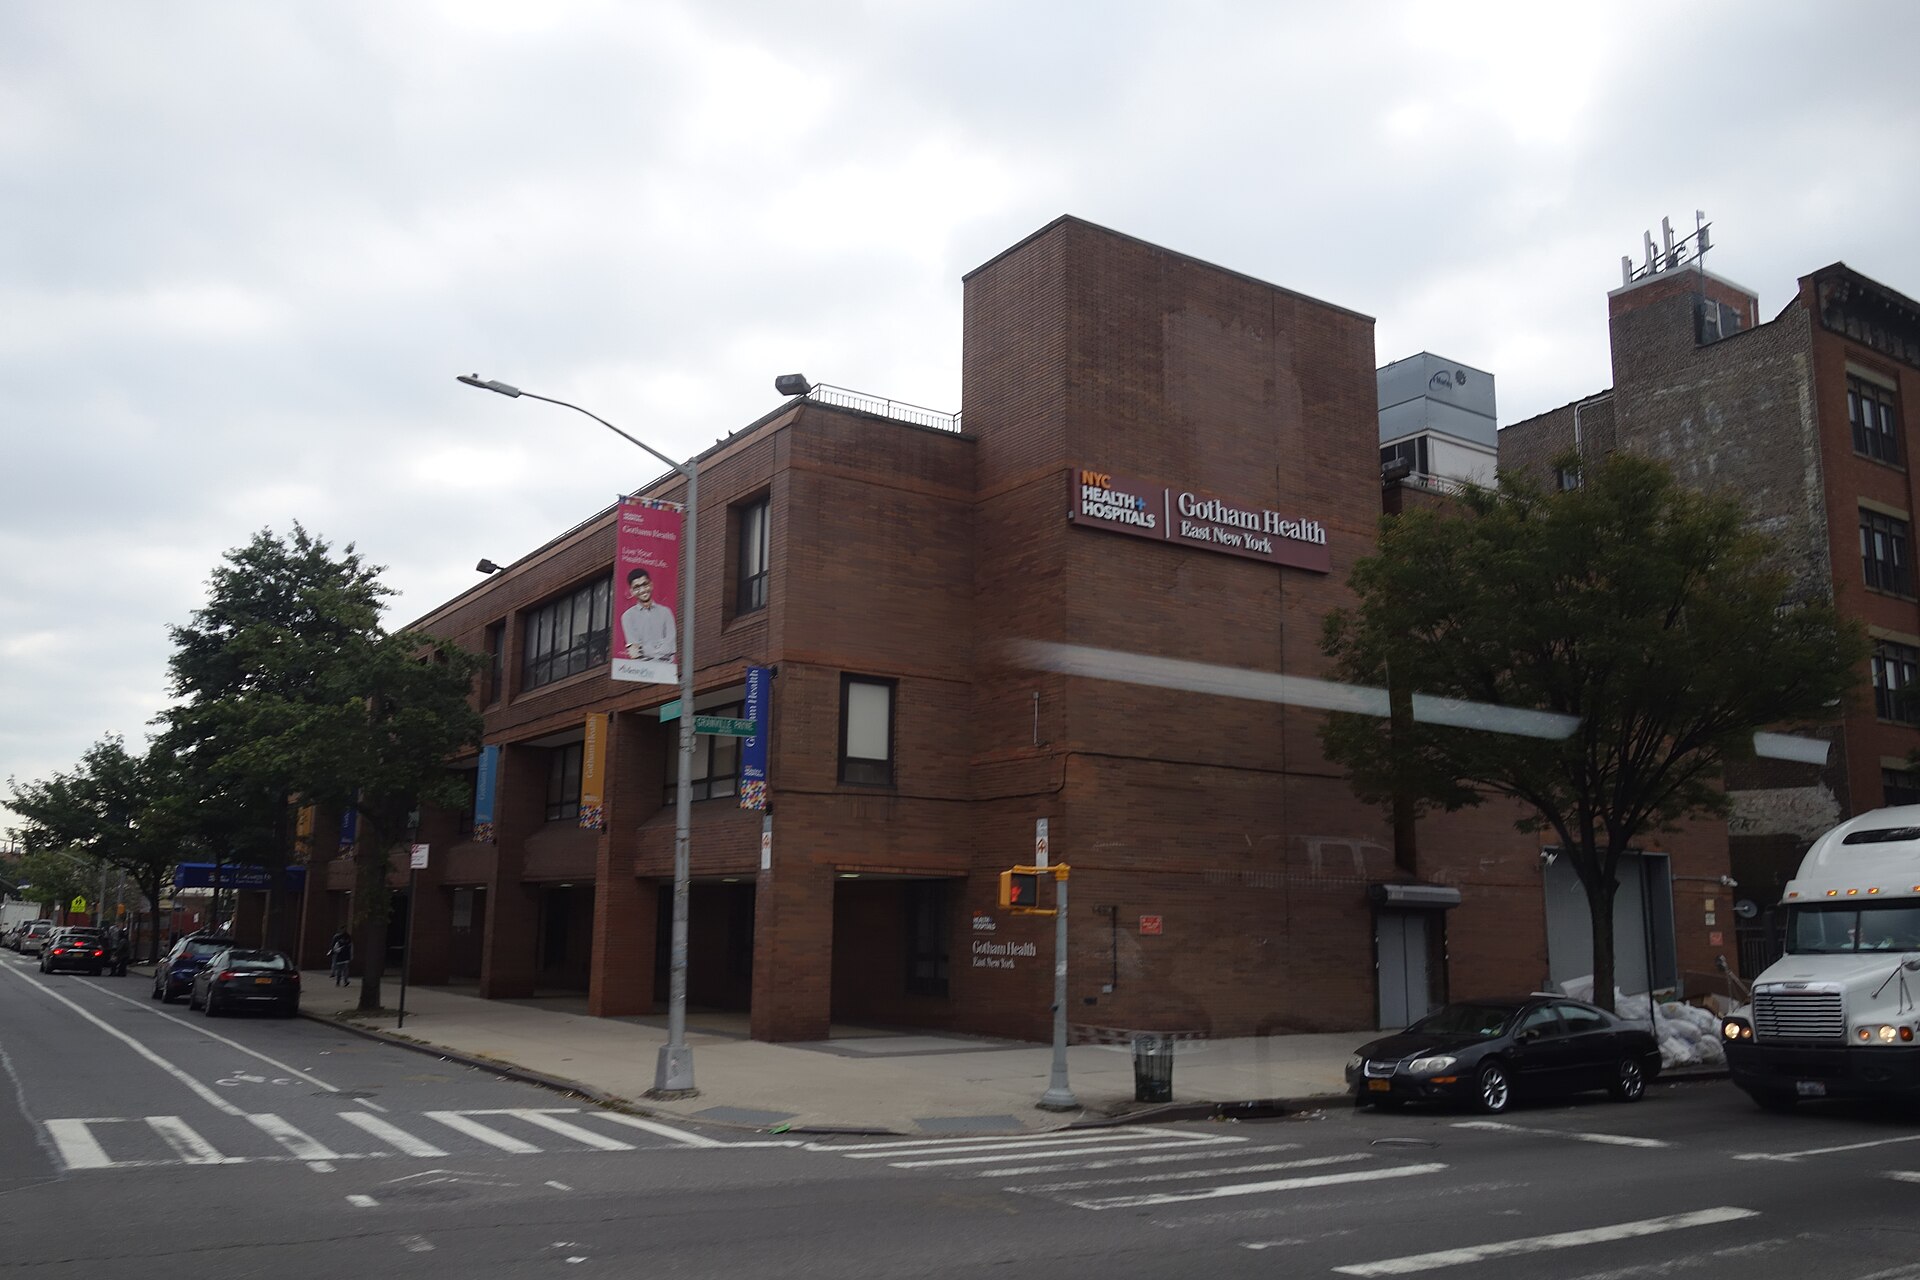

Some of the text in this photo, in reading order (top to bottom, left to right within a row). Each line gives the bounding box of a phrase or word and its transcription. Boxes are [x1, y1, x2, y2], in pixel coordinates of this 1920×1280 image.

[1081, 470, 1111, 488] NYC
[1081, 500, 1155, 528] HOSPITALS
[1178, 492, 1327, 545] Gotham Health
[622, 525, 652, 537] Gotham
[1180, 520, 1272, 554] East New York
[748, 669, 759, 704] Health
[972, 940, 1037, 957] Gotham Health
[972, 956, 1016, 969] East New York
